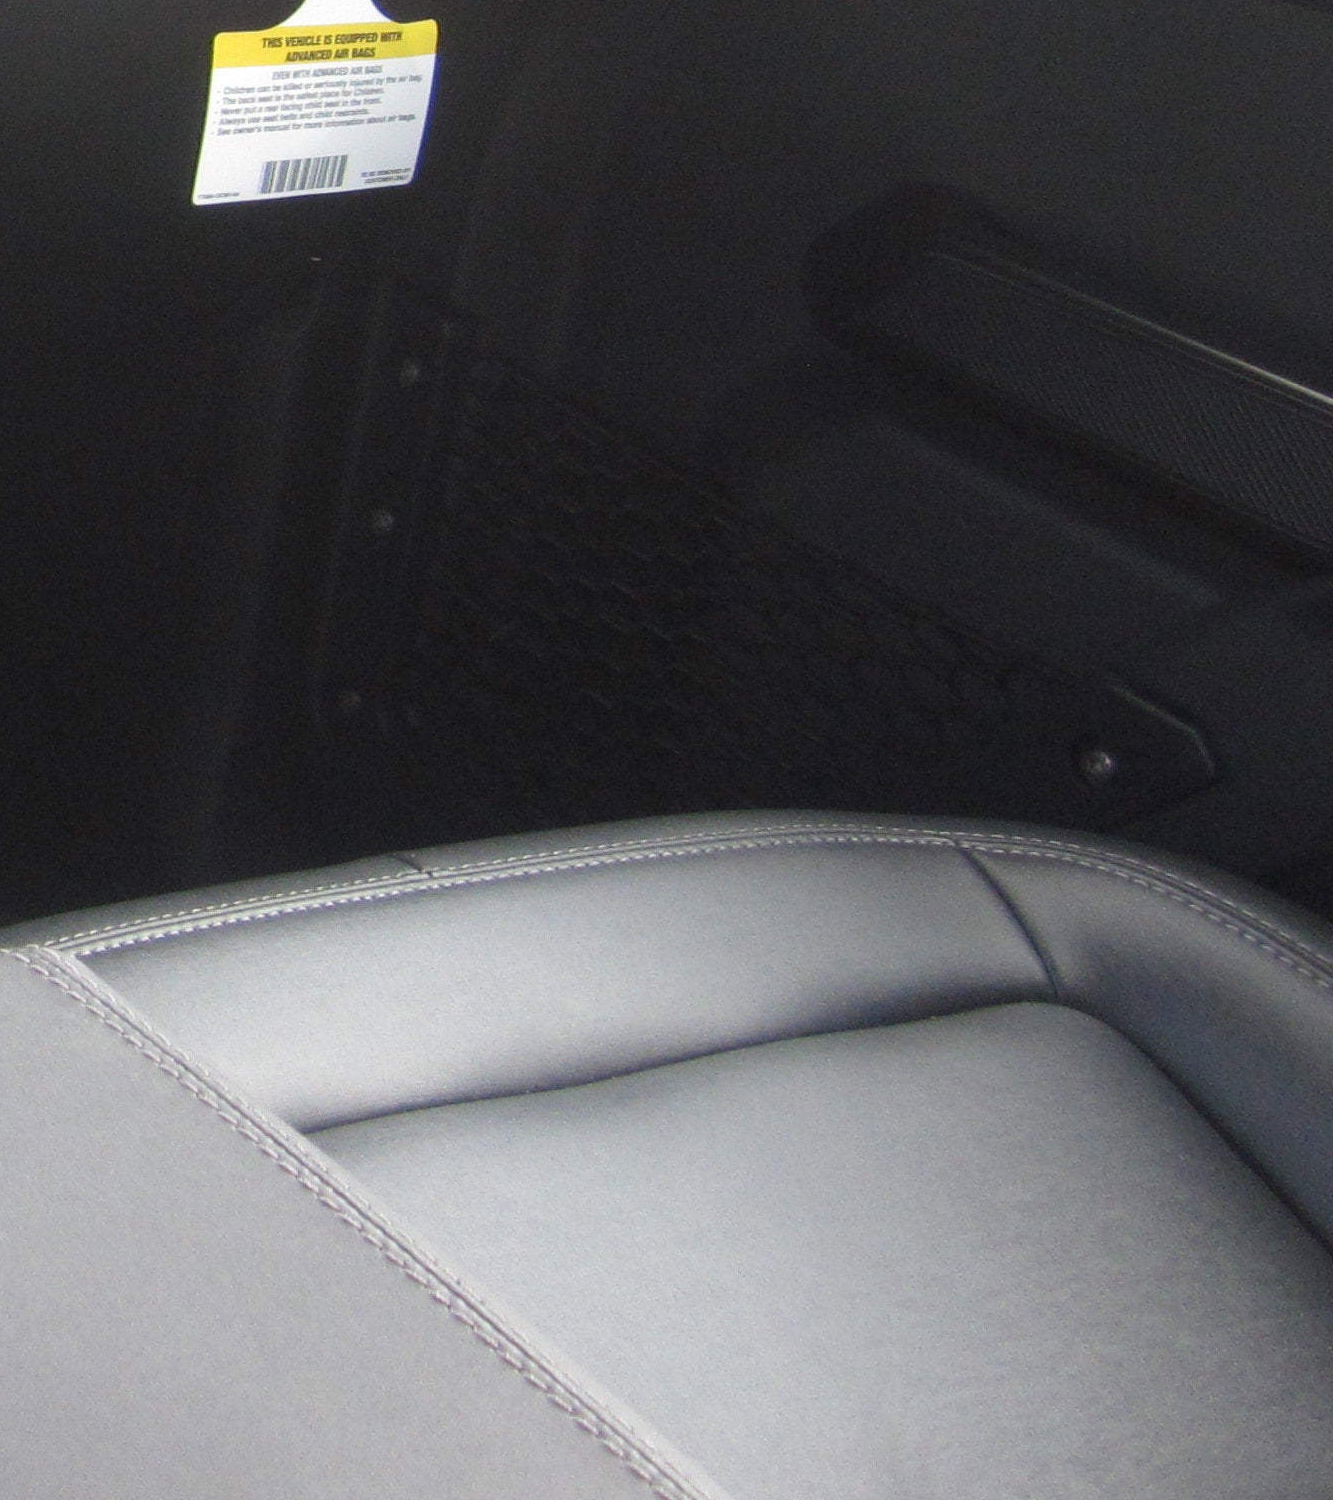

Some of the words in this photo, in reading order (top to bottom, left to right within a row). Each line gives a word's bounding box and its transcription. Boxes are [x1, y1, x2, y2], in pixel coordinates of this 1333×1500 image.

[262, 37, 283, 48] THIS
[285, 35, 322, 47] VEHICLE
[323, 35, 333, 45] IS
[334, 32, 378, 45] EQUIPPED
[380, 31, 402, 42] WITH
[285, 49, 333, 62] ADVANCED
[334, 48, 350, 59] AIR
[352, 47, 376, 58] BAGS
